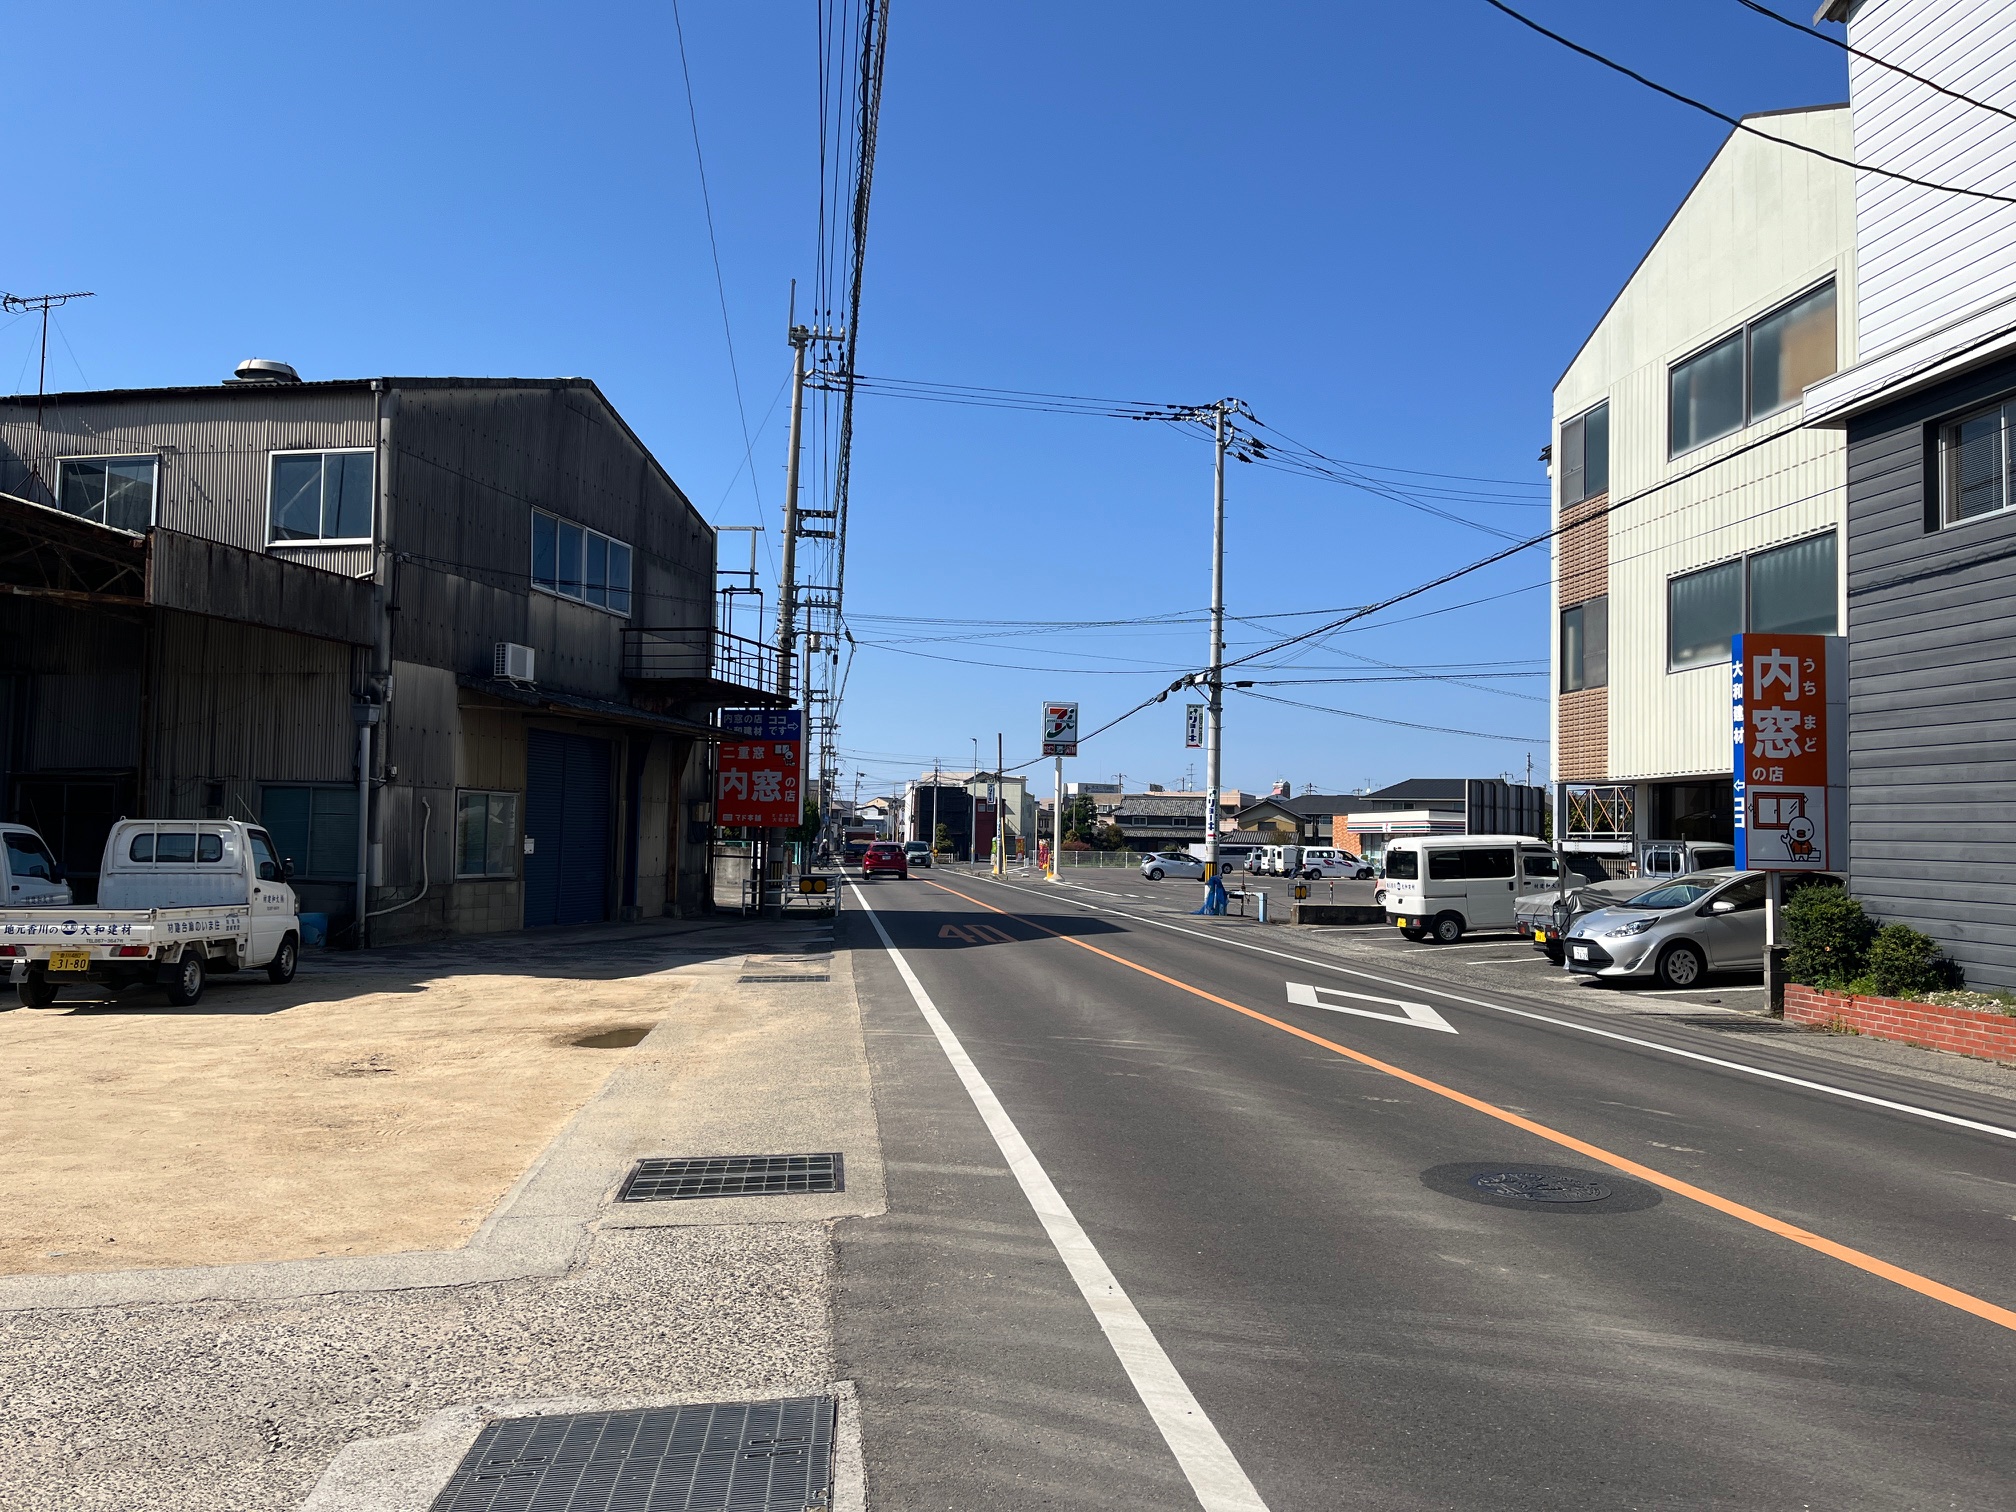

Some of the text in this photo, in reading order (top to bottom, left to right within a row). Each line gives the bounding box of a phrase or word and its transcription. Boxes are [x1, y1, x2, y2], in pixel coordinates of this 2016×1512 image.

[1732, 660, 1745, 744] 大和建材
[1752, 648, 1802, 759] 内窓
[724, 714, 787, 724] 内窓の店 ココ
[769, 726, 787, 735] です
[723, 746, 765, 759] 二重窓
[1752, 766, 1784, 782] の店
[719, 767, 796, 802] 内窓 の店
[4, 924, 59, 935] 地元香川の
[80, 923, 132, 936] 大和建材
[938, 924, 1020, 943] 40
[57, 959, 87, 969] 31-80
